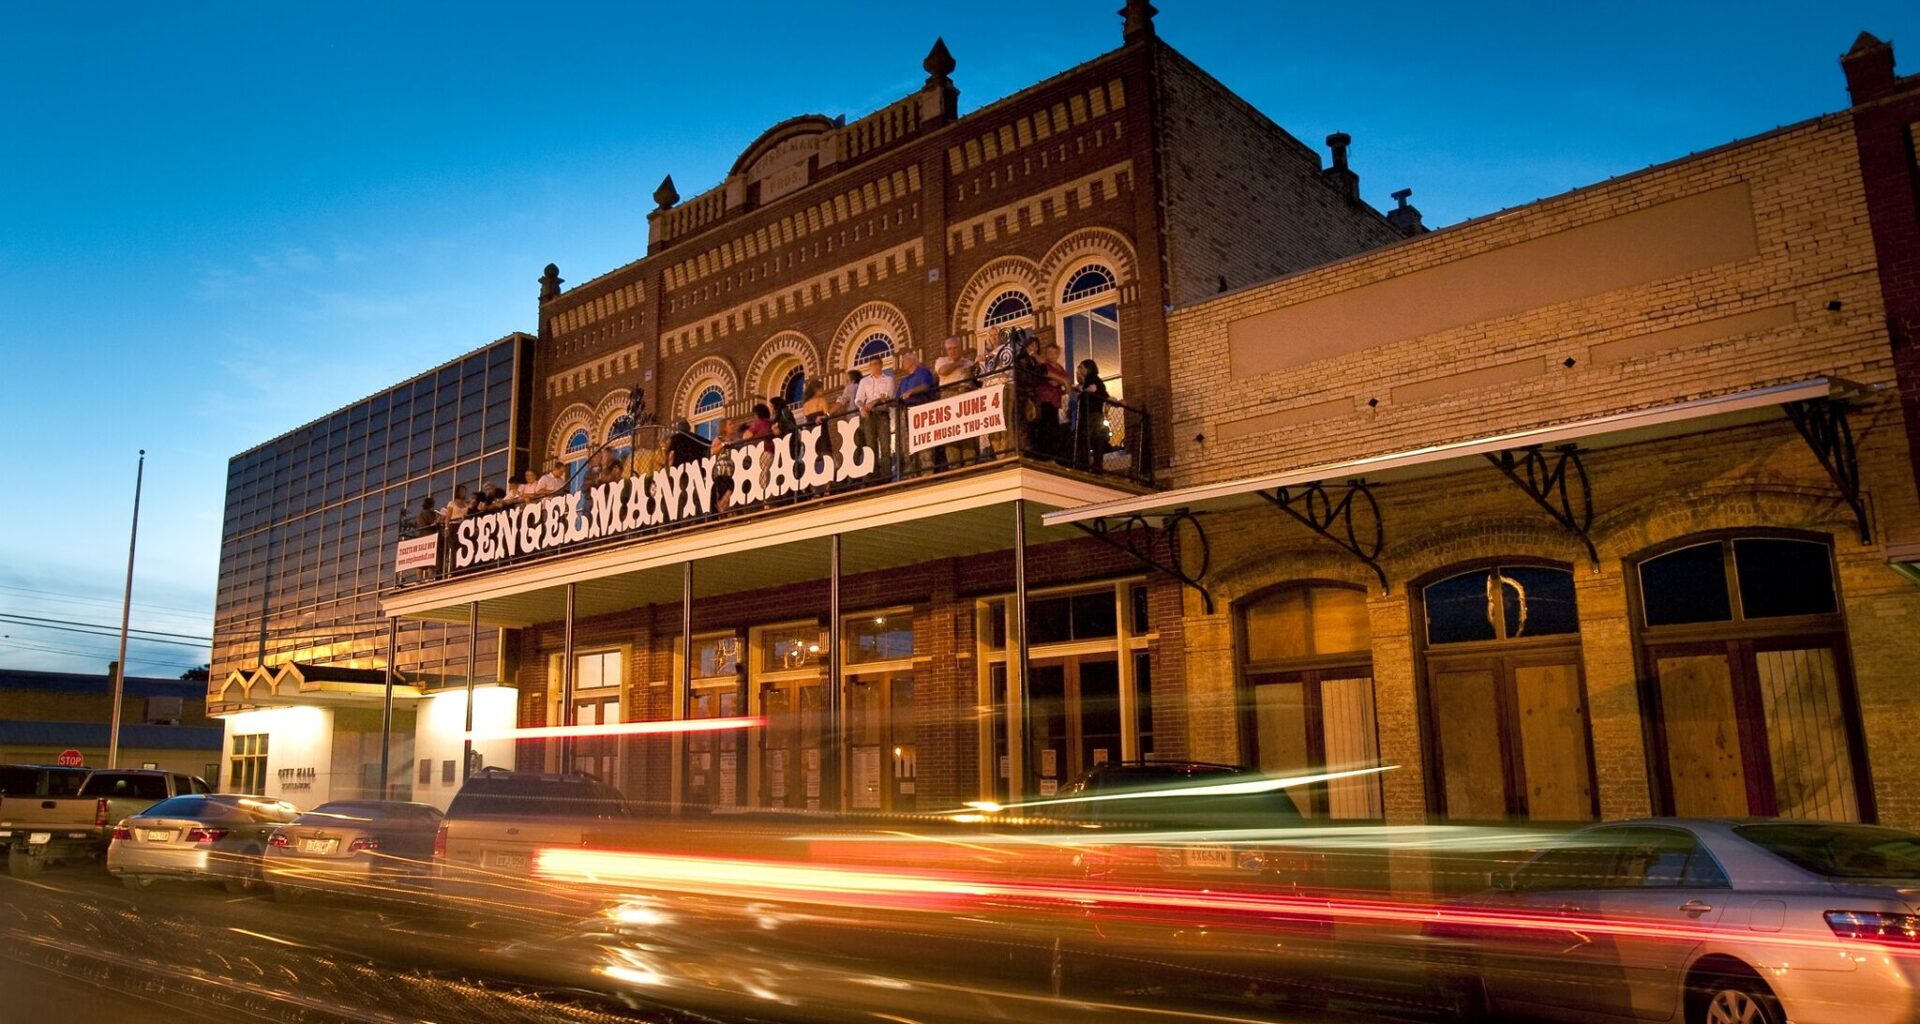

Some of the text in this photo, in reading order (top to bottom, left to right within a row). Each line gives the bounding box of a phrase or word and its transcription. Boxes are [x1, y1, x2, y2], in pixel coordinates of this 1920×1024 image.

[913, 392, 1000, 430] OPENS JUNE 4
[913, 414, 1001, 447] LIVE MUSIC THU-SUN
[455, 416, 875, 569] SENGELMANN HALL
[60, 756, 82, 767] STOP
[278, 767, 316, 779] CITY HALL
